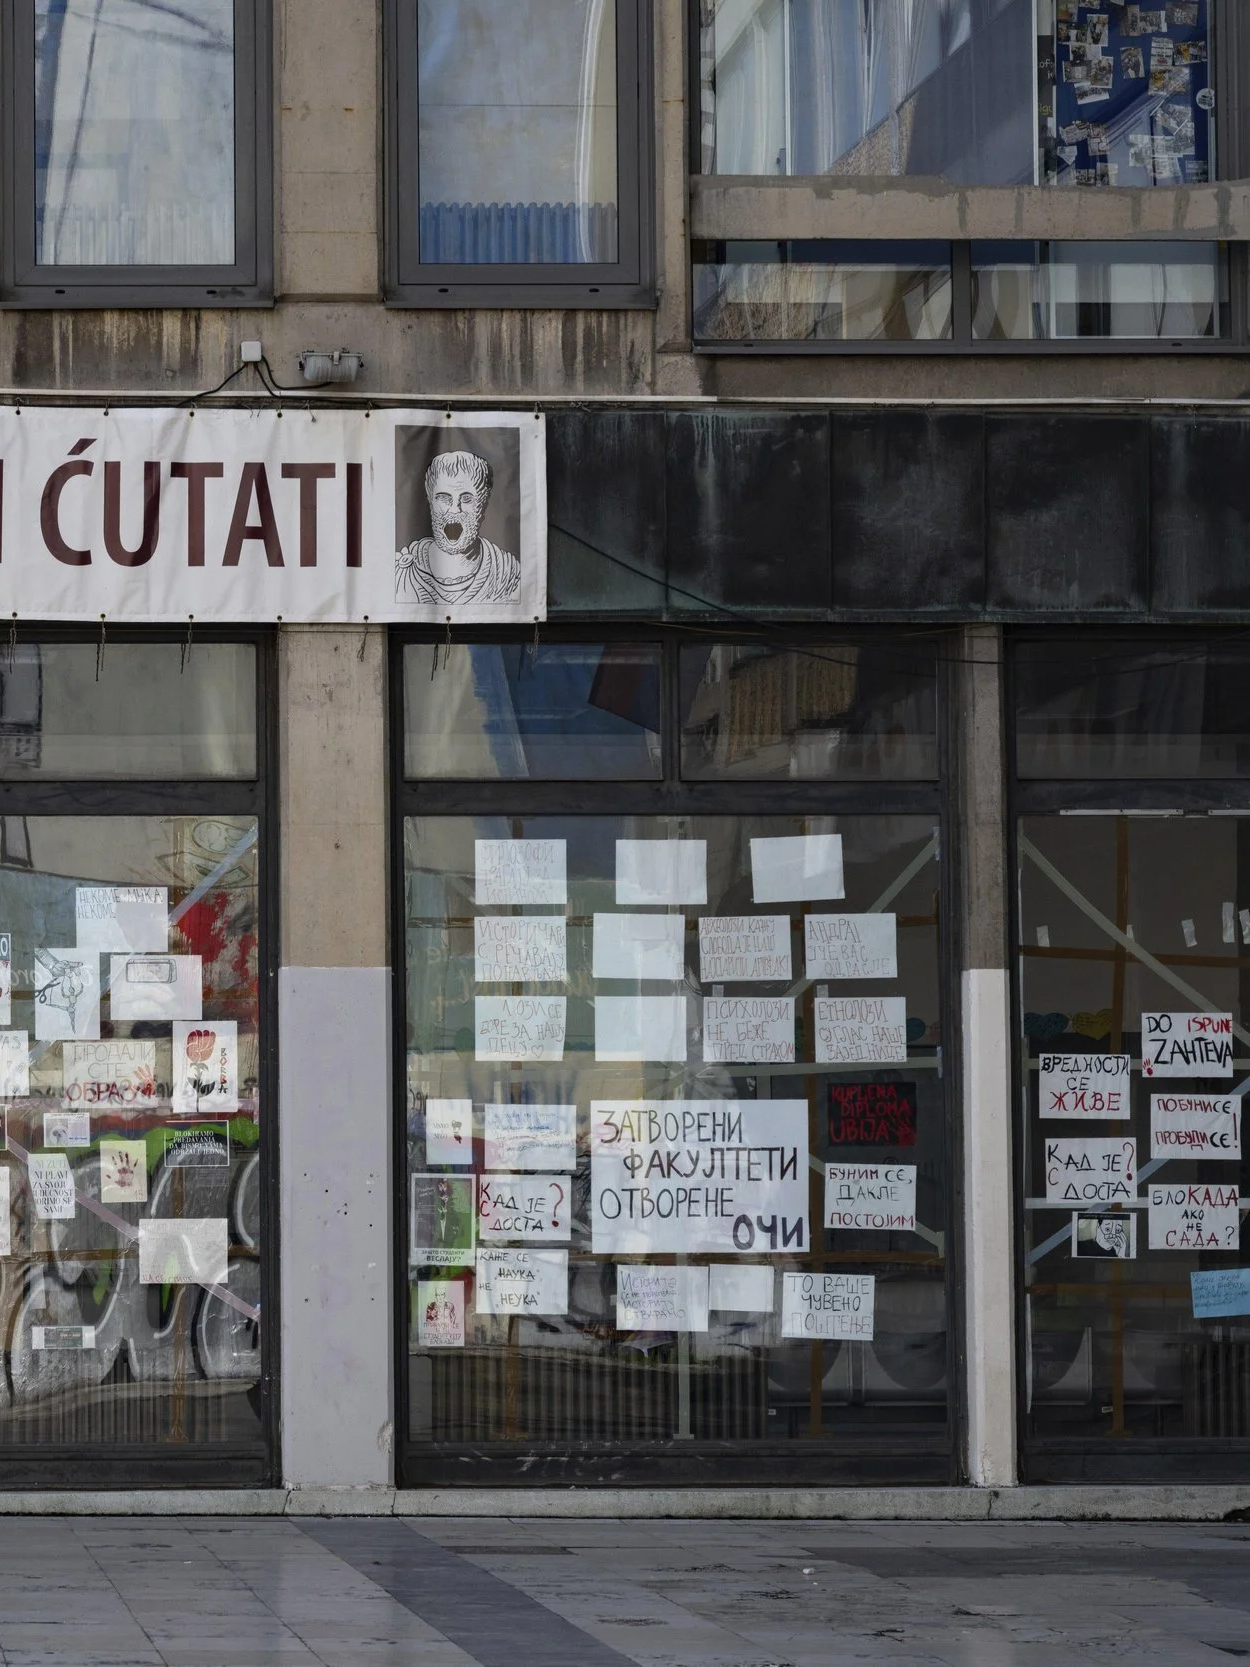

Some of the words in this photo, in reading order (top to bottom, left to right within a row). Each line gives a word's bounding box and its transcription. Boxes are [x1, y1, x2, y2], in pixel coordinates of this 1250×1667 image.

[40, 438, 362, 568] ĆUTATI
[79, 888, 121, 903] НЕКОМЕ
[748, 917, 775, 934] КАЖУ
[807, 944, 839, 961] УЧЕ
[840, 944, 868, 962] ВАС
[548, 1003, 562, 1018] СЕ
[707, 999, 791, 1022] ПСИХОЛОЗИ
[818, 999, 889, 1025] ЕТНОЛОЗИ
[511, 1022, 532, 1041] ЗА
[707, 1021, 729, 1041] НЕ
[736, 1020, 770, 1041] БЕЖЕ
[1147, 1014, 1172, 1033] DO
[833, 1025, 867, 1045] ГЛАС
[872, 1025, 907, 1045] НАШЕ
[73, 1042, 155, 1063] ПРОДАЛИ
[713, 1041, 748, 1060] ПРЕД
[751, 1040, 794, 1060] СТРАХОМ
[826, 1042, 905, 1061] ЗАЈЕДНИЦЕ
[1149, 1037, 1234, 1068] ZAHTEVA
[88, 1062, 127, 1079] СТЕ
[1041, 1056, 1130, 1076] ВРЕДНОСТИ
[66, 1077, 138, 1103] ОБРАЗ
[1067, 1077, 1090, 1091] СЕ
[841, 1099, 911, 1117] DIPLOMA
[1049, 1091, 1121, 1112] ЖИВЕ
[598, 1109, 743, 1144] ЗАТВОРЕНИ
[830, 1118, 890, 1142] UBIJA
[623, 1146, 797, 1182] ФАКУЛТЕТИ
[1102, 1154, 1123, 1172] ЈЕ
[35, 1171, 42, 1179] NI
[45, 1171, 68, 1179] PLAVI
[829, 1168, 879, 1180] БУНИМ
[836, 1184, 900, 1206] ДАКЛЕ
[1063, 1181, 1131, 1200] ДОСТА
[1152, 1185, 1239, 1208] БЛОКАДА
[524, 1198, 547, 1214] ЈЕ
[600, 1187, 735, 1219] ОТВОРЕНЕ
[830, 1212, 914, 1229] ПОСТОЈИМ
[1181, 1209, 1204, 1220] АКО
[489, 1217, 545, 1232] ДОСТА
[732, 1214, 803, 1250] ОЧИ
[1186, 1222, 1203, 1232] НЕ
[1165, 1231, 1219, 1247] САДА
[480, 1251, 509, 1262] КАЖЕ
[516, 1252, 529, 1263] СЕ
[478, 1282, 493, 1291] НЕ
[787, 1275, 814, 1294] ТО
[823, 1276, 871, 1295] ВАШЕ
[801, 1295, 861, 1312] ЧУВЕНО
